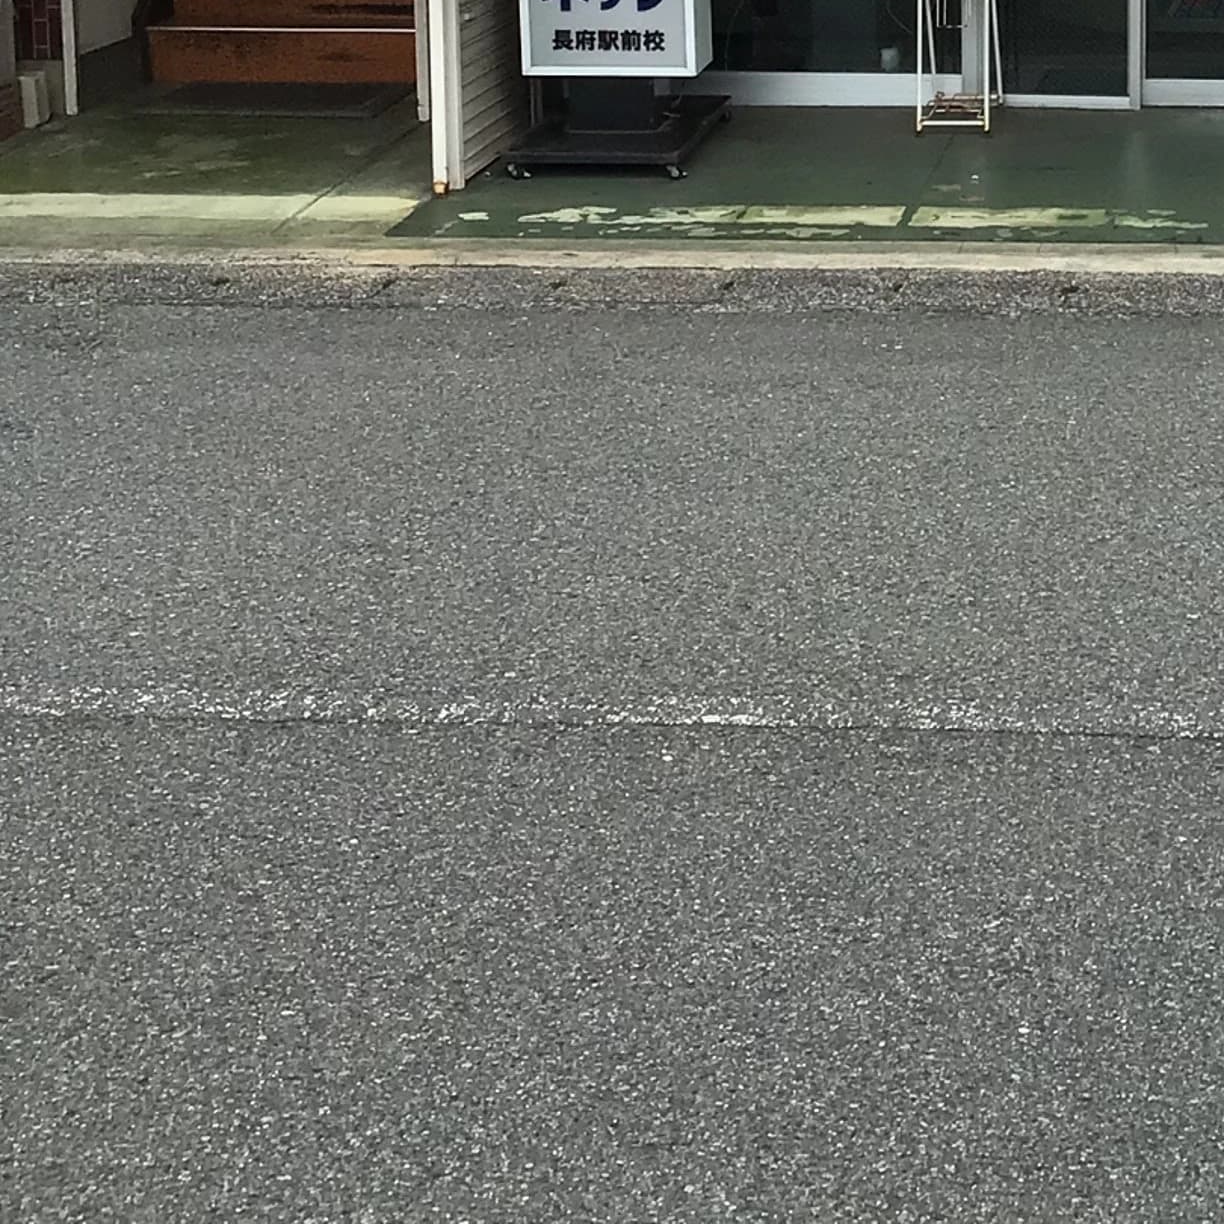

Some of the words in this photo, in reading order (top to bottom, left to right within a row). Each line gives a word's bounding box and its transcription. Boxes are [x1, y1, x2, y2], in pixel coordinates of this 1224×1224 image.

[552, 30, 666, 52] 長府駅前校
